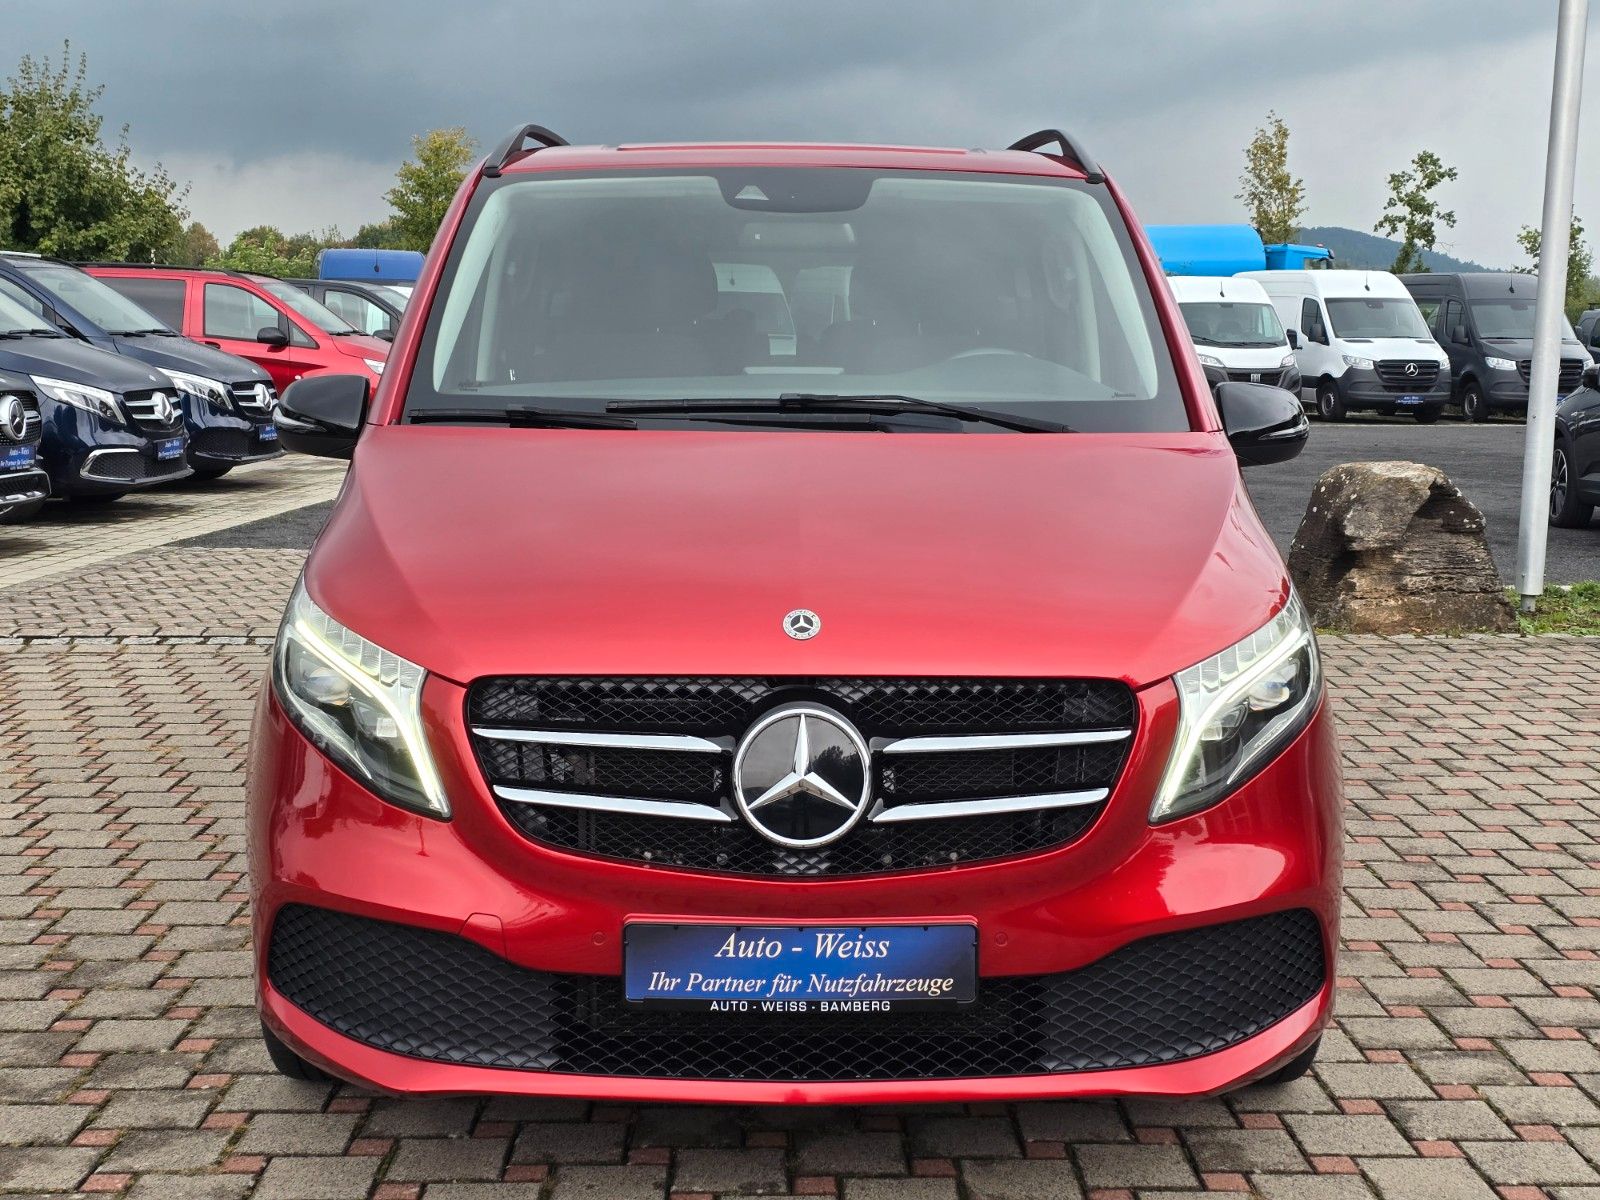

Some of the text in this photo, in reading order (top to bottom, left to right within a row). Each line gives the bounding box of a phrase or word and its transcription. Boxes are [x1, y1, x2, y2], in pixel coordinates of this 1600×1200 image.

[714, 932, 782, 958] Auto
[815, 933, 890, 959] Weiss
[648, 972, 954, 998] Ihr Partner für Nutzfahrzeuge
[710, 1001, 748, 1011] AUTO
[761, 1001, 807, 1011] WEISS
[820, 1001, 891, 1011] BAMBERG
